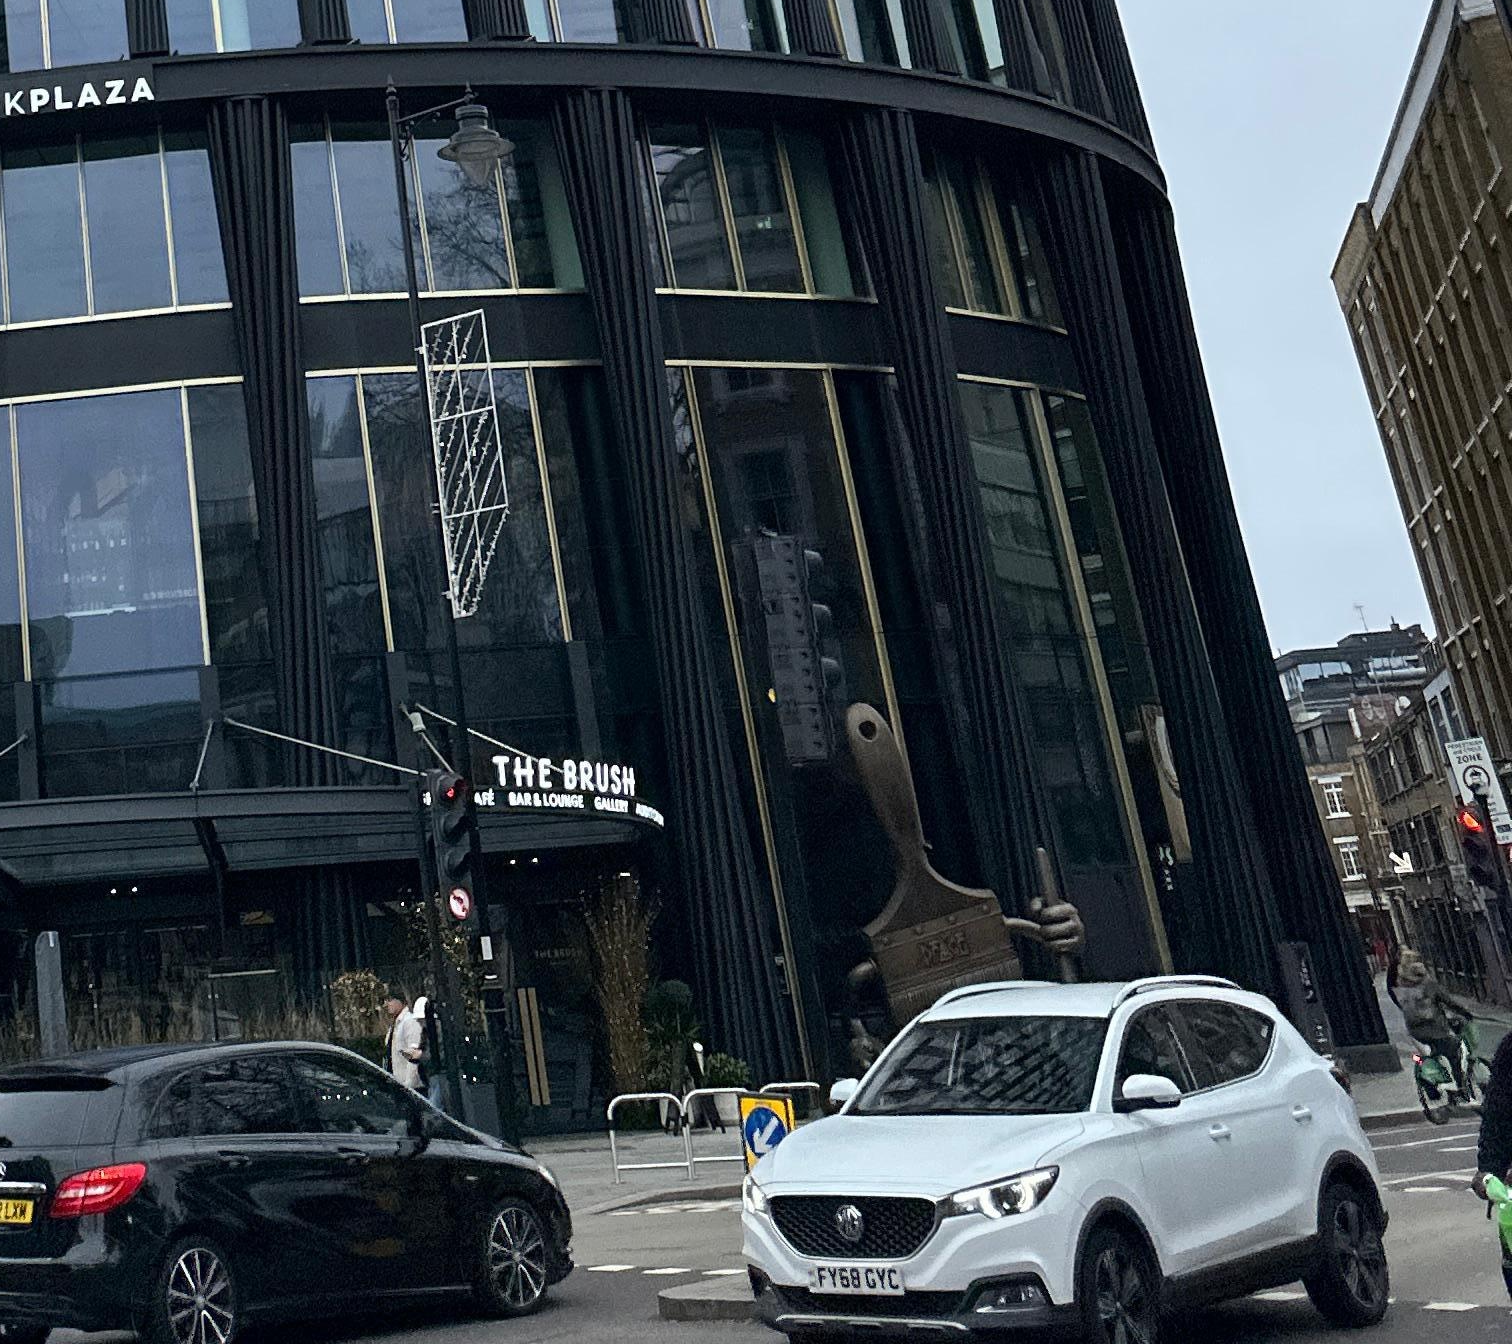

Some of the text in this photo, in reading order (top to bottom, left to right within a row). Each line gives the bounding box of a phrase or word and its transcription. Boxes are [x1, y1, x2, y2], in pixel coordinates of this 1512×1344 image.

[1456, 753, 1483, 764] ZONE
[492, 755, 636, 796] THE BRUSH
[474, 788, 495, 806] AFÉ
[508, 791, 532, 806] BAR
[543, 793, 585, 809] LOUNGE
[817, 1267, 899, 1289] FY68 GYC
